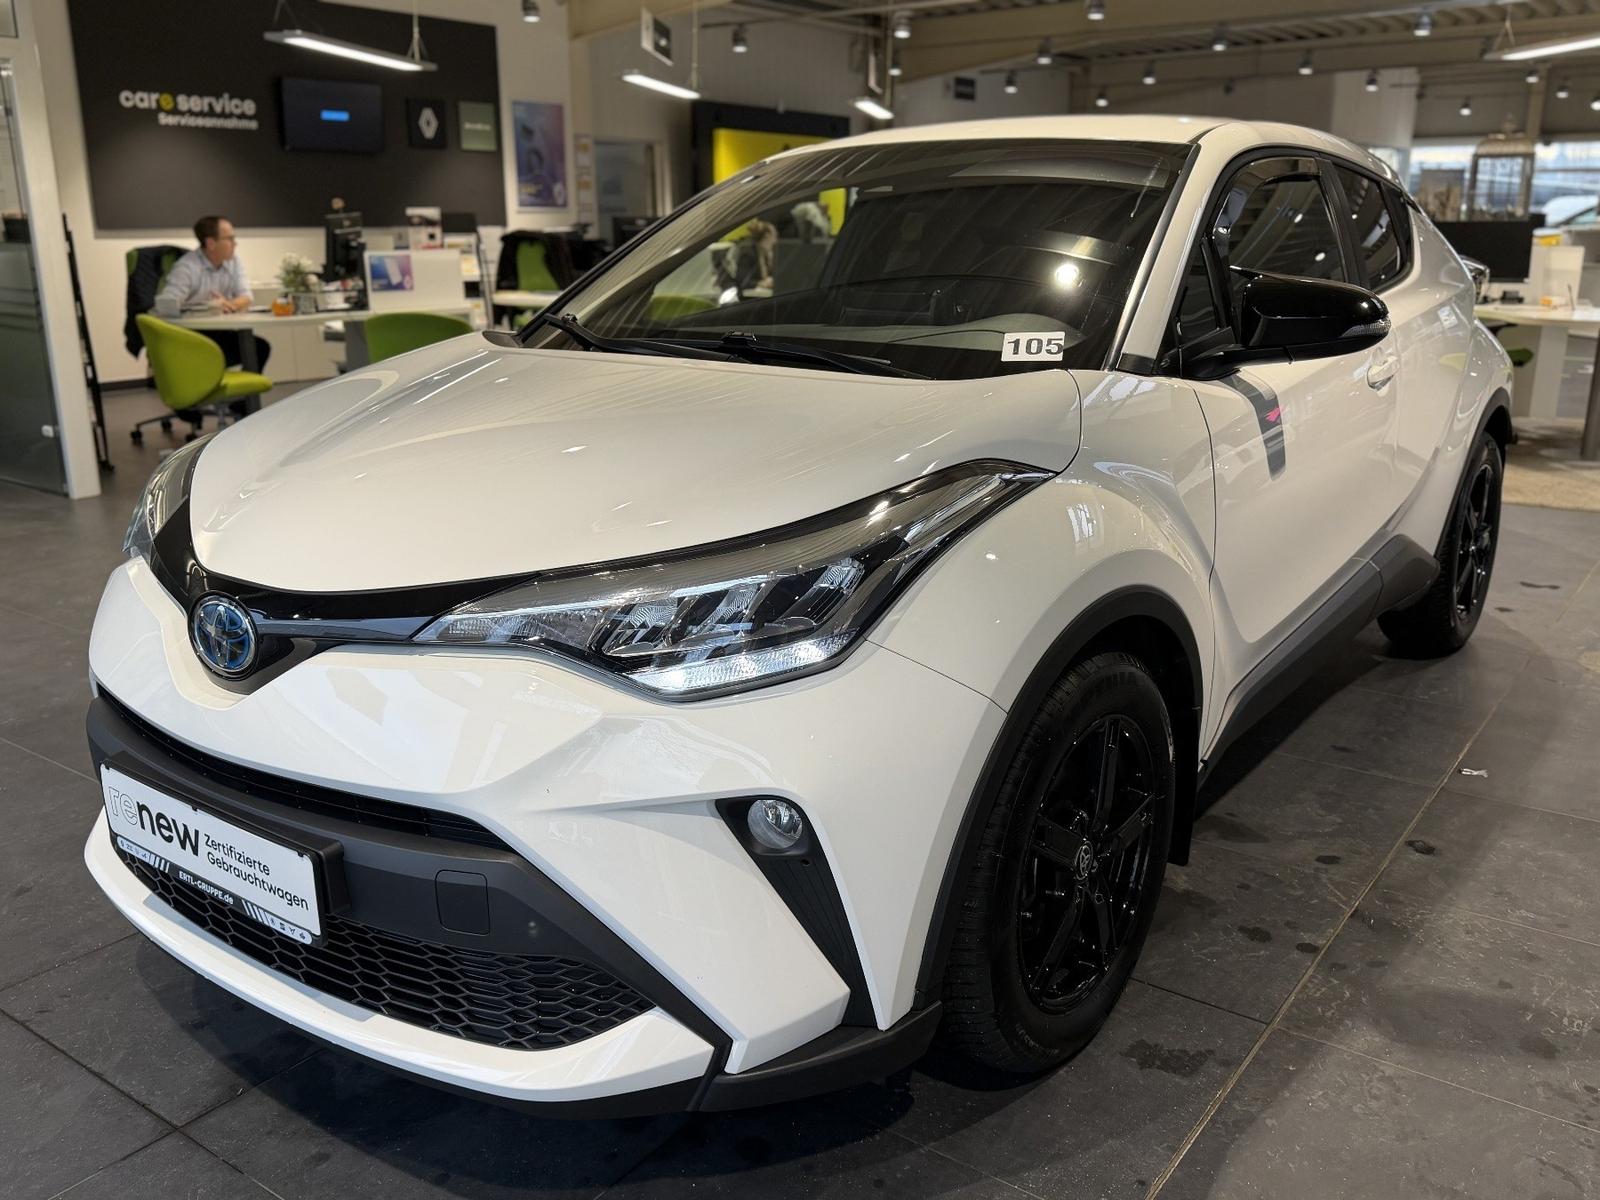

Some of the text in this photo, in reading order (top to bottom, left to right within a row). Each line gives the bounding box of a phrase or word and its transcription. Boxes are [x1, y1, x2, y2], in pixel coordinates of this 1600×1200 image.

[119, 90, 256, 116] care service
[1008, 338, 1063, 355] 105
[108, 786, 200, 857] renew
[204, 834, 270, 876] Zertifizierte
[178, 871, 234, 905] ERTL-GRUPPE.de
[207, 851, 309, 911] Gebrauchtwagen
